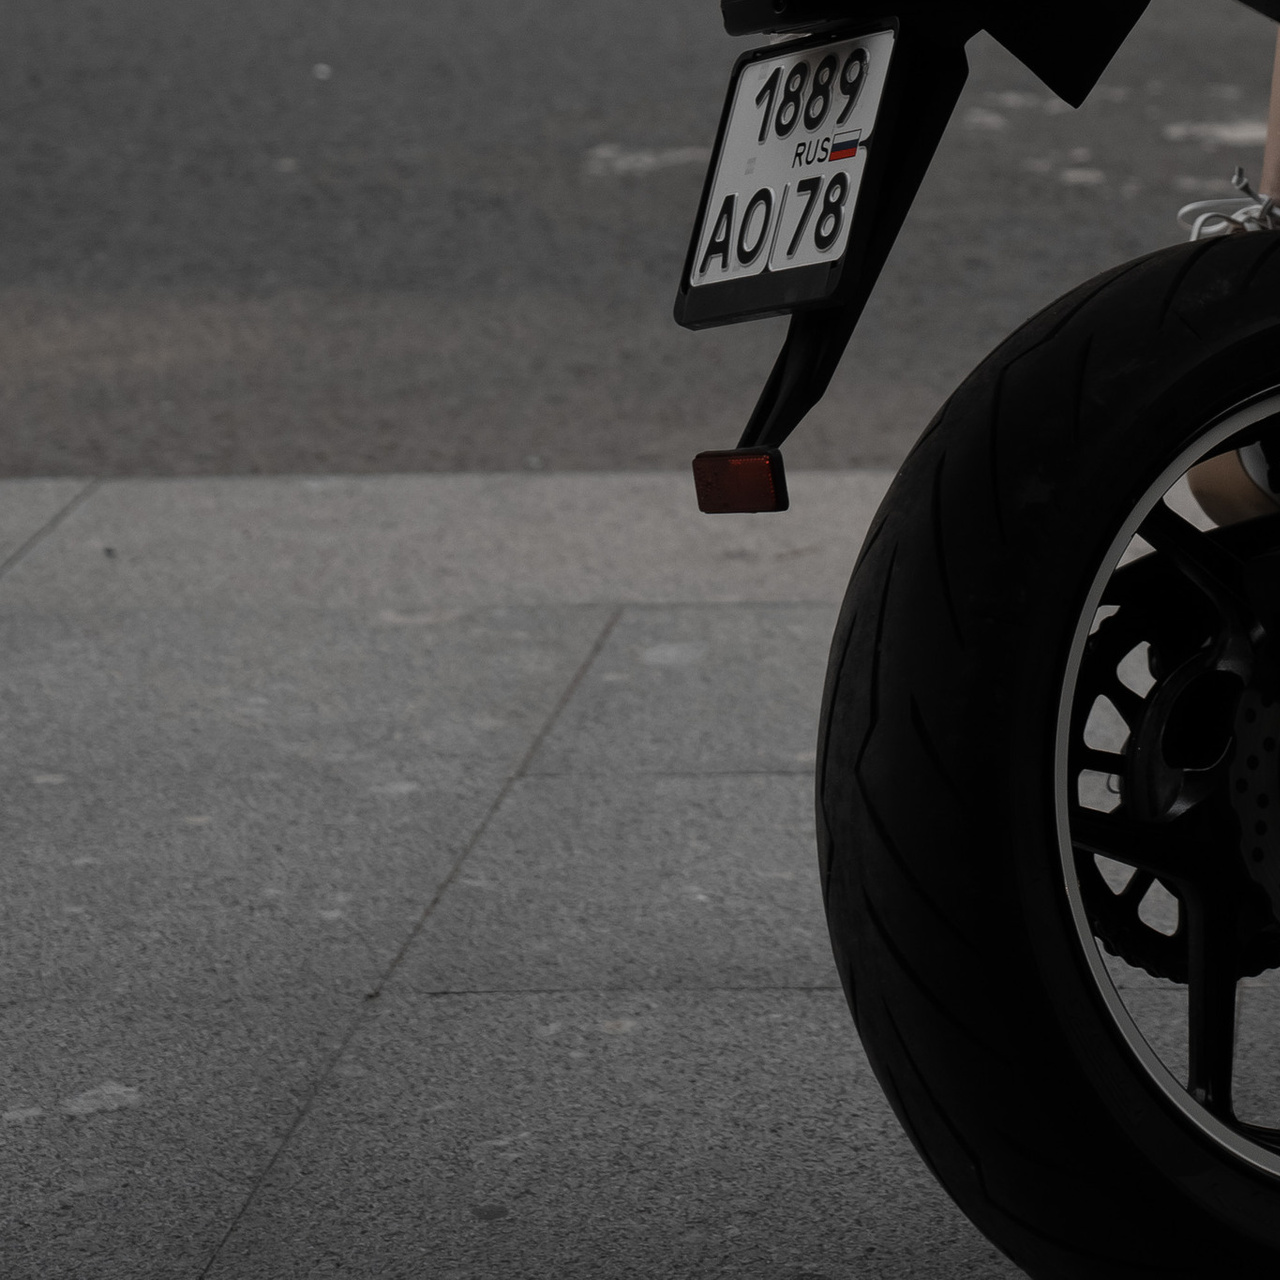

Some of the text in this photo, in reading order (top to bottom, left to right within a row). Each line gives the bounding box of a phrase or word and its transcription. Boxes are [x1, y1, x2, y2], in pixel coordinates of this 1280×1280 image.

[755, 48, 869, 143] 1889
[792, 137, 831, 168] RUS
[700, 171, 849, 274] AO 78
